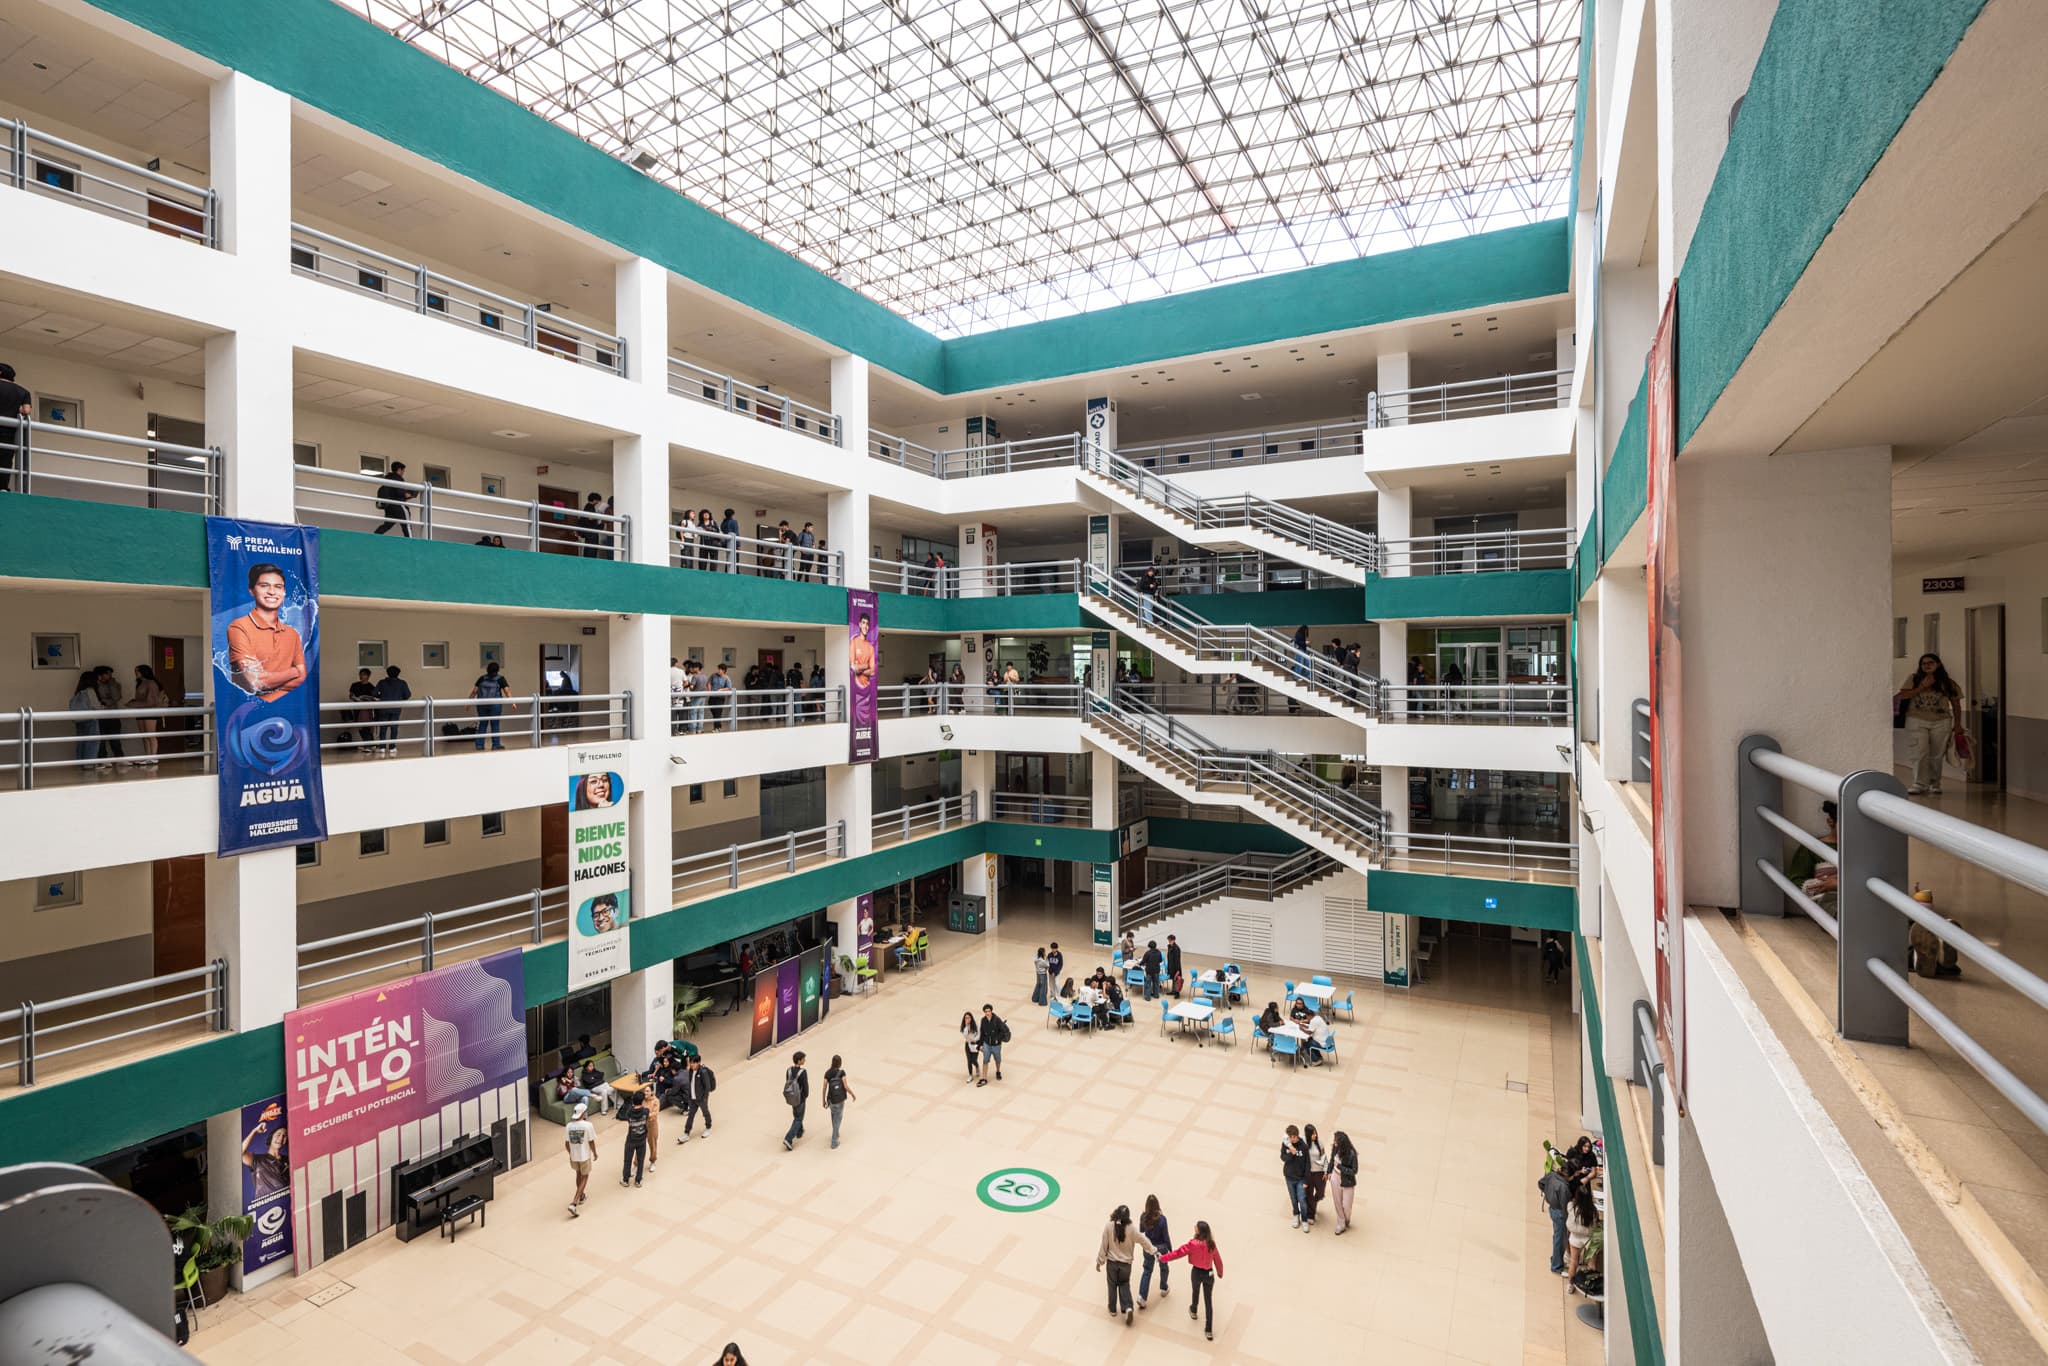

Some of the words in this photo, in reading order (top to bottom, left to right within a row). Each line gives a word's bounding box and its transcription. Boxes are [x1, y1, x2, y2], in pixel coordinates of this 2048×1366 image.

[244, 536, 274, 546] PREPA
[245, 544, 303, 556] TECMILENIO
[1924, 580, 1955, 590] 2303
[588, 752, 622, 761] TECMILENIO
[243, 780, 286, 789] HALCONES
[240, 785, 306, 807] AGUA
[249, 818, 298, 830] #TODOSSOMOS
[249, 824, 299, 837] HALCONES
[575, 821, 625, 844] BIENVE
[578, 841, 622, 864] NIDOS
[574, 861, 626, 882] HALCONES
[297, 1048, 412, 1111] TALO
[303, 1109, 354, 1136] DESCUBRE
[354, 1105, 367, 1117] TU
[368, 1087, 416, 1111] POTENCIAL
